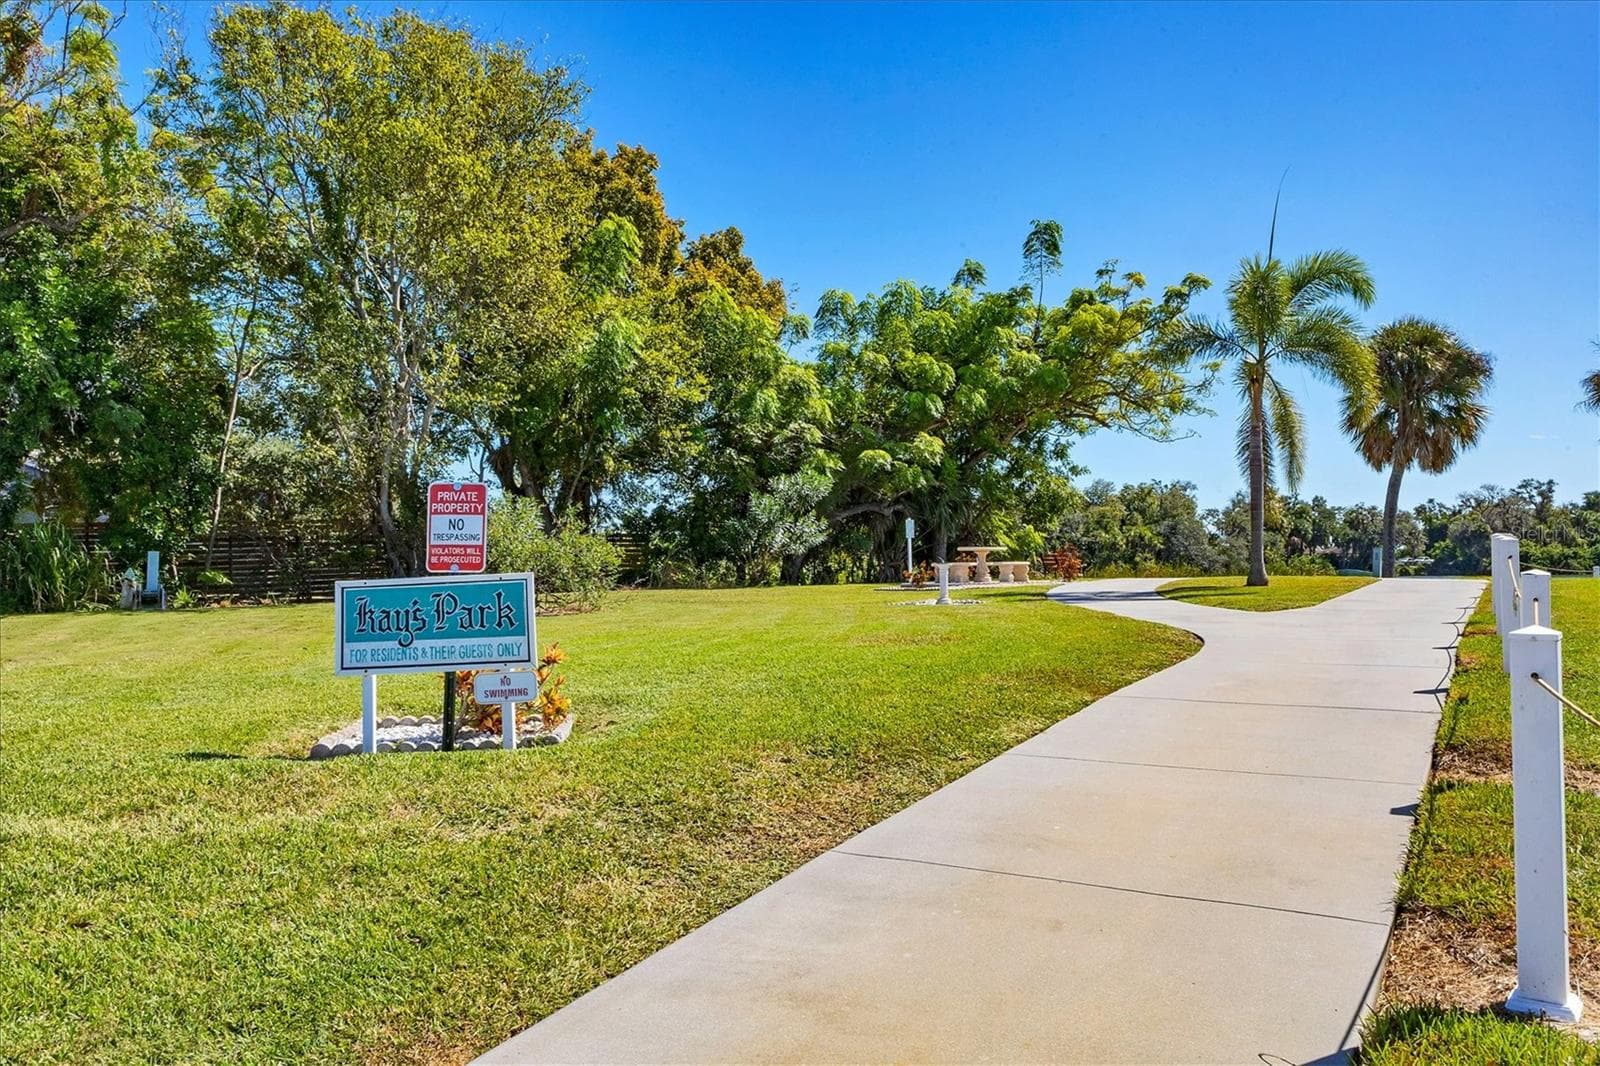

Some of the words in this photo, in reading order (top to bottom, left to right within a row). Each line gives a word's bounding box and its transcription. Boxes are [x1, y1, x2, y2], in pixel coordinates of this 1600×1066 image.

[437, 491, 478, 502] PRIVATE
[432, 503, 483, 513] PROPERTY
[449, 519, 464, 530] NO
[433, 533, 480, 541] TRESPASSING
[440, 556, 481, 564] PROSECUTED
[431, 589, 518, 632] Park
[350, 649, 368, 663] FOR
[371, 647, 418, 663] RESIDENTS
[421, 649, 428, 658] &
[430, 647, 456, 659] THEIR
[459, 645, 493, 658] GUESTS
[498, 643, 523, 657] ONLY
[500, 676, 511, 686] NO
[484, 688, 528, 698] SWIMMING
